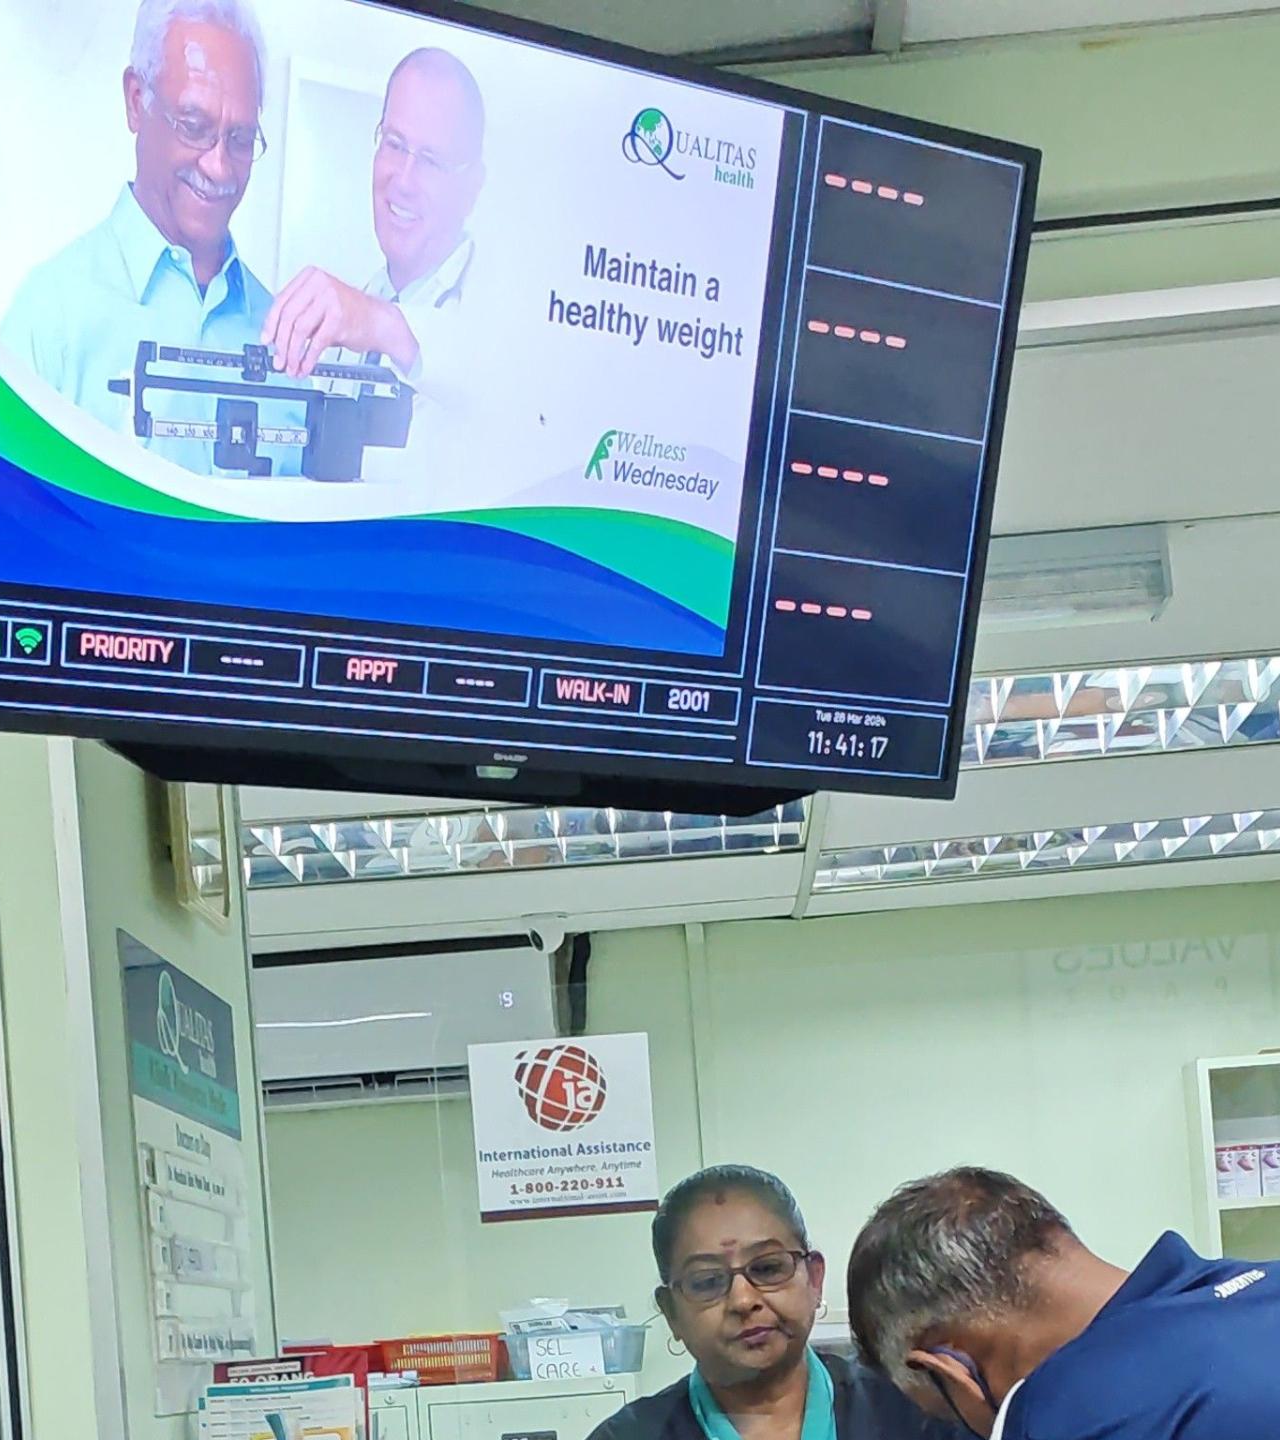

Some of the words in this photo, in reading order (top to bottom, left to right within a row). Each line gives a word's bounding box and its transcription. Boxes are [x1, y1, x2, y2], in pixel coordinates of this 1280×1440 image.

[622, 107, 757, 181] QUALITAS
[714, 165, 754, 189] health
[583, 244, 697, 298] Maintain
[705, 277, 720, 302] a
[548, 290, 649, 346] healthy
[657, 318, 743, 359] weight
[616, 431, 687, 462] Wellness
[613, 460, 719, 500] Wednesday
[80, 632, 174, 664] PRIORITY
[346, 657, 398, 684] APPT
[556, 677, 630, 705] WALK-IN
[668, 688, 710, 713] 2001
[808, 731, 888, 759] 11:41:17
[479, 1143, 572, 1163] International
[576, 1140, 651, 1156] Assistance
[491, 1167, 545, 1179] Healthcare
[601, 1161, 642, 1173] Anytime
[510, 1176, 625, 1196] 1-800-220-911
[536, 1338, 571, 1357] SEL
[536, 1362, 582, 1380] CARE
